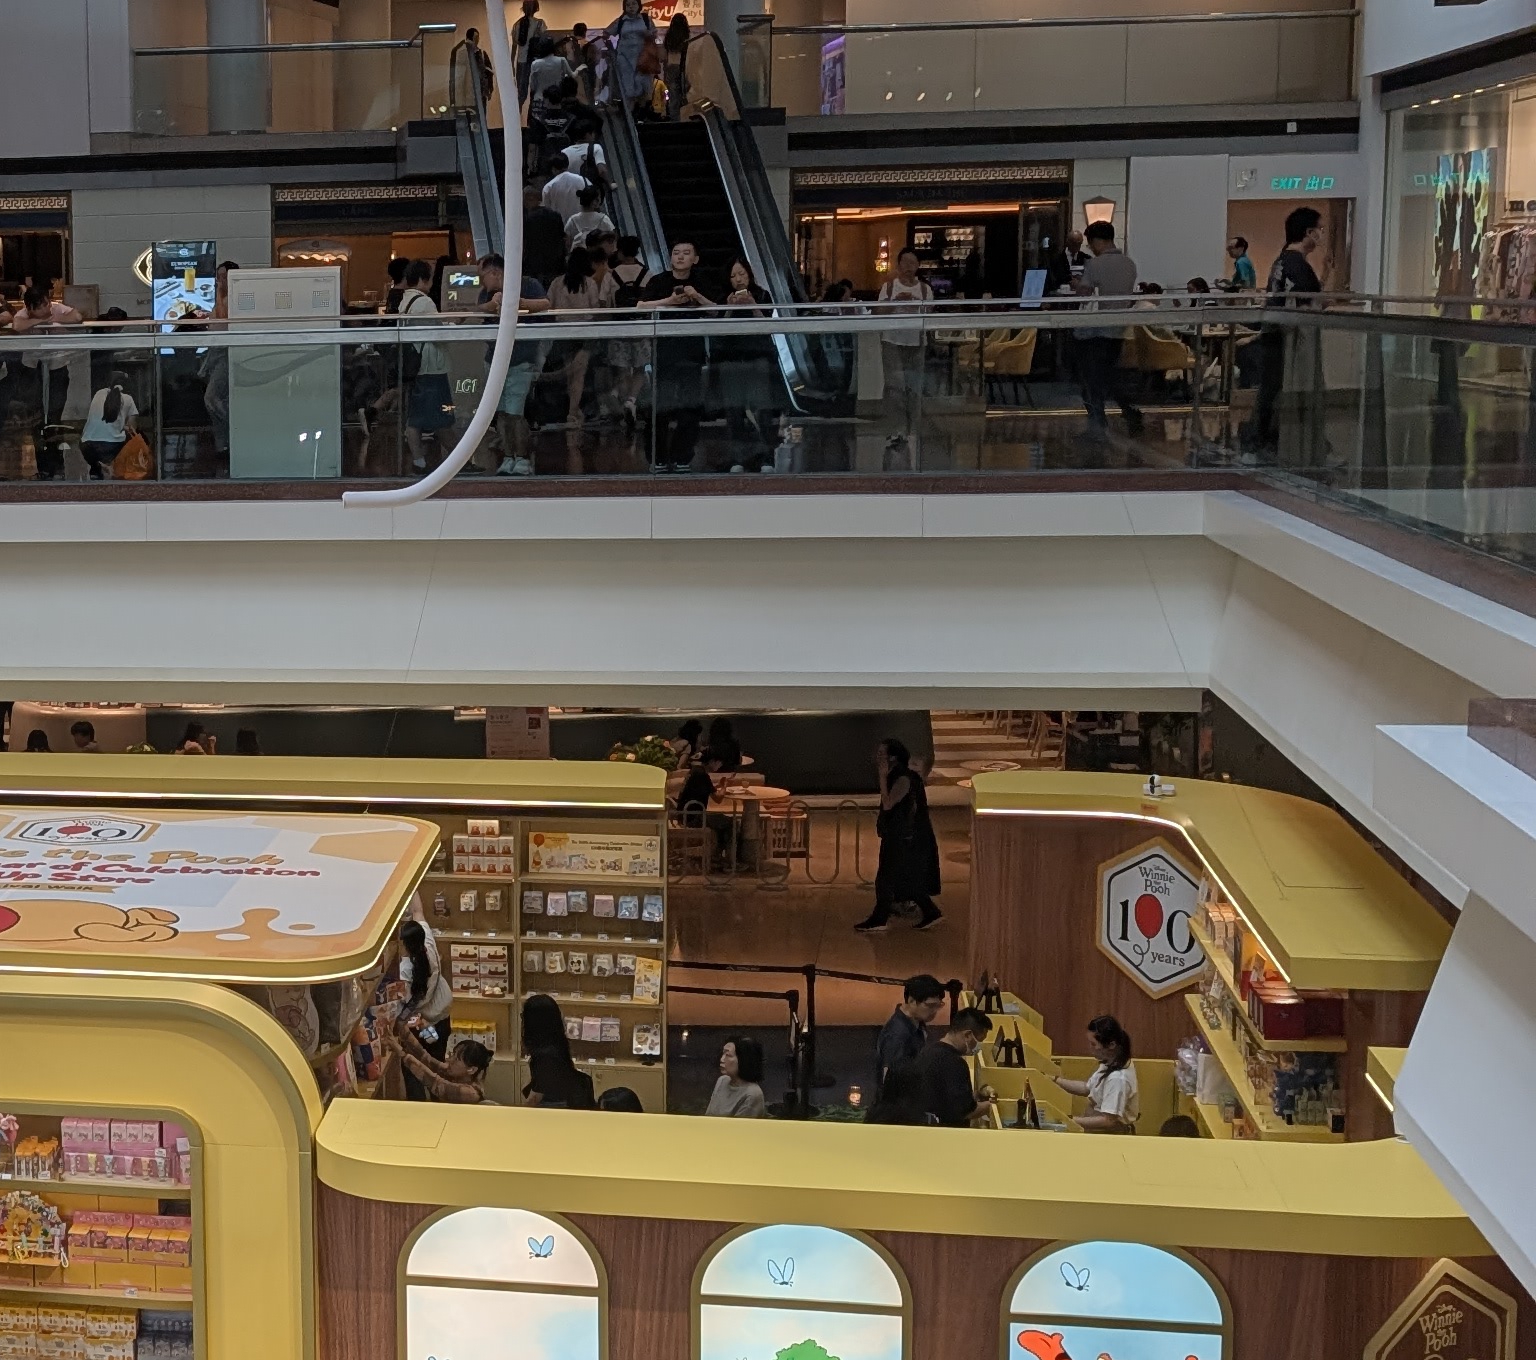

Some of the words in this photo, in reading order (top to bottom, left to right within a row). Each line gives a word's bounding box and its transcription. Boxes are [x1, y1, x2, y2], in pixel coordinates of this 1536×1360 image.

[1270, 176, 1302, 190] EXIT
[1305, 175, 1335, 191] 出口
[42, 848, 136, 862] the
[148, 850, 285, 866] Pooh
[49, 861, 92, 872] of
[92, 863, 321, 877] Celebration
[1138, 866, 1176, 884] Winnie
[47, 872, 155, 884] Store
[1143, 878, 1171, 897] Pooh
[1150, 951, 1186, 968] years
[1418, 1309, 1464, 1334] Winnie
[1424, 1326, 1458, 1355] Pooh
